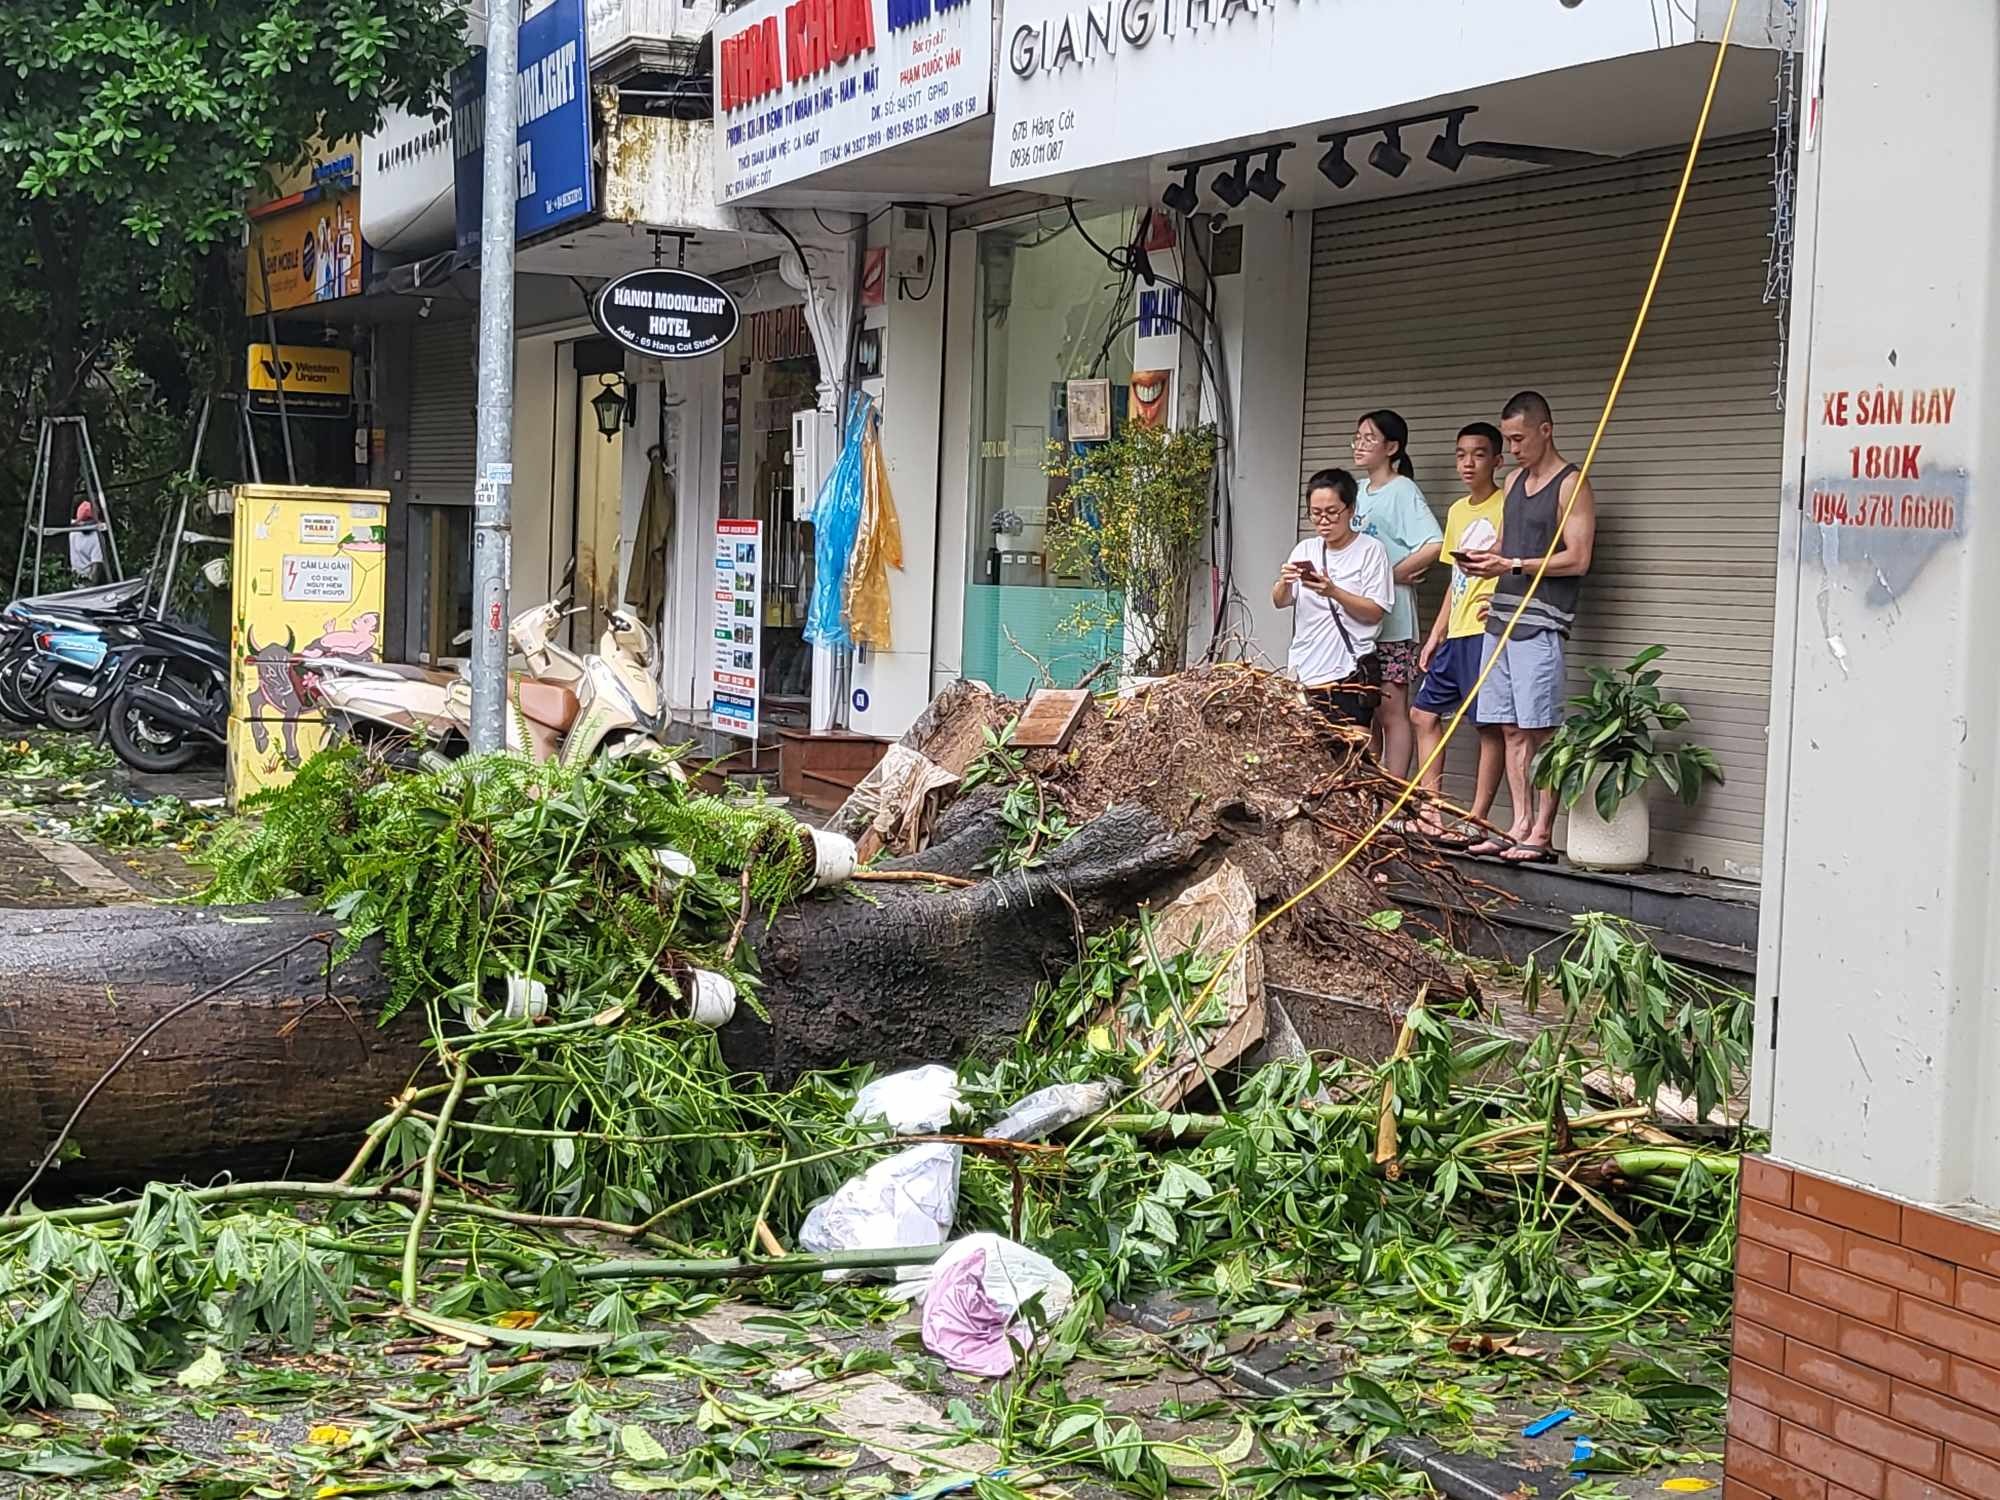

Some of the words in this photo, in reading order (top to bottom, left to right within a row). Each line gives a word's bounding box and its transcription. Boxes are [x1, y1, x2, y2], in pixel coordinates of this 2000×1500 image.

[721, 16, 782, 114] NHA
[786, 0, 876, 84] KHOA
[1012, 120, 1028, 141] 67B
[1032, 115, 1054, 138] Hàng
[1058, 108, 1075, 131] Cót
[1010, 146, 1031, 168] 0936
[1046, 140, 1064, 162] 087
[614, 286, 652, 308] HANOI
[655, 292, 725, 315] MOONLIGHT
[617, 325, 635, 341] Add
[652, 342, 675, 353] Hang
[677, 342, 693, 352] Cot
[694, 334, 719, 349] Street
[649, 316, 691, 338] HOTEL
[296, 361, 340, 374] Western
[296, 372, 327, 383] Union
[1822, 391, 1849, 426] XE
[1856, 384, 1904, 426] SÂN
[1910, 387, 1956, 425] BAY
[1849, 444, 1922, 479] 180K
